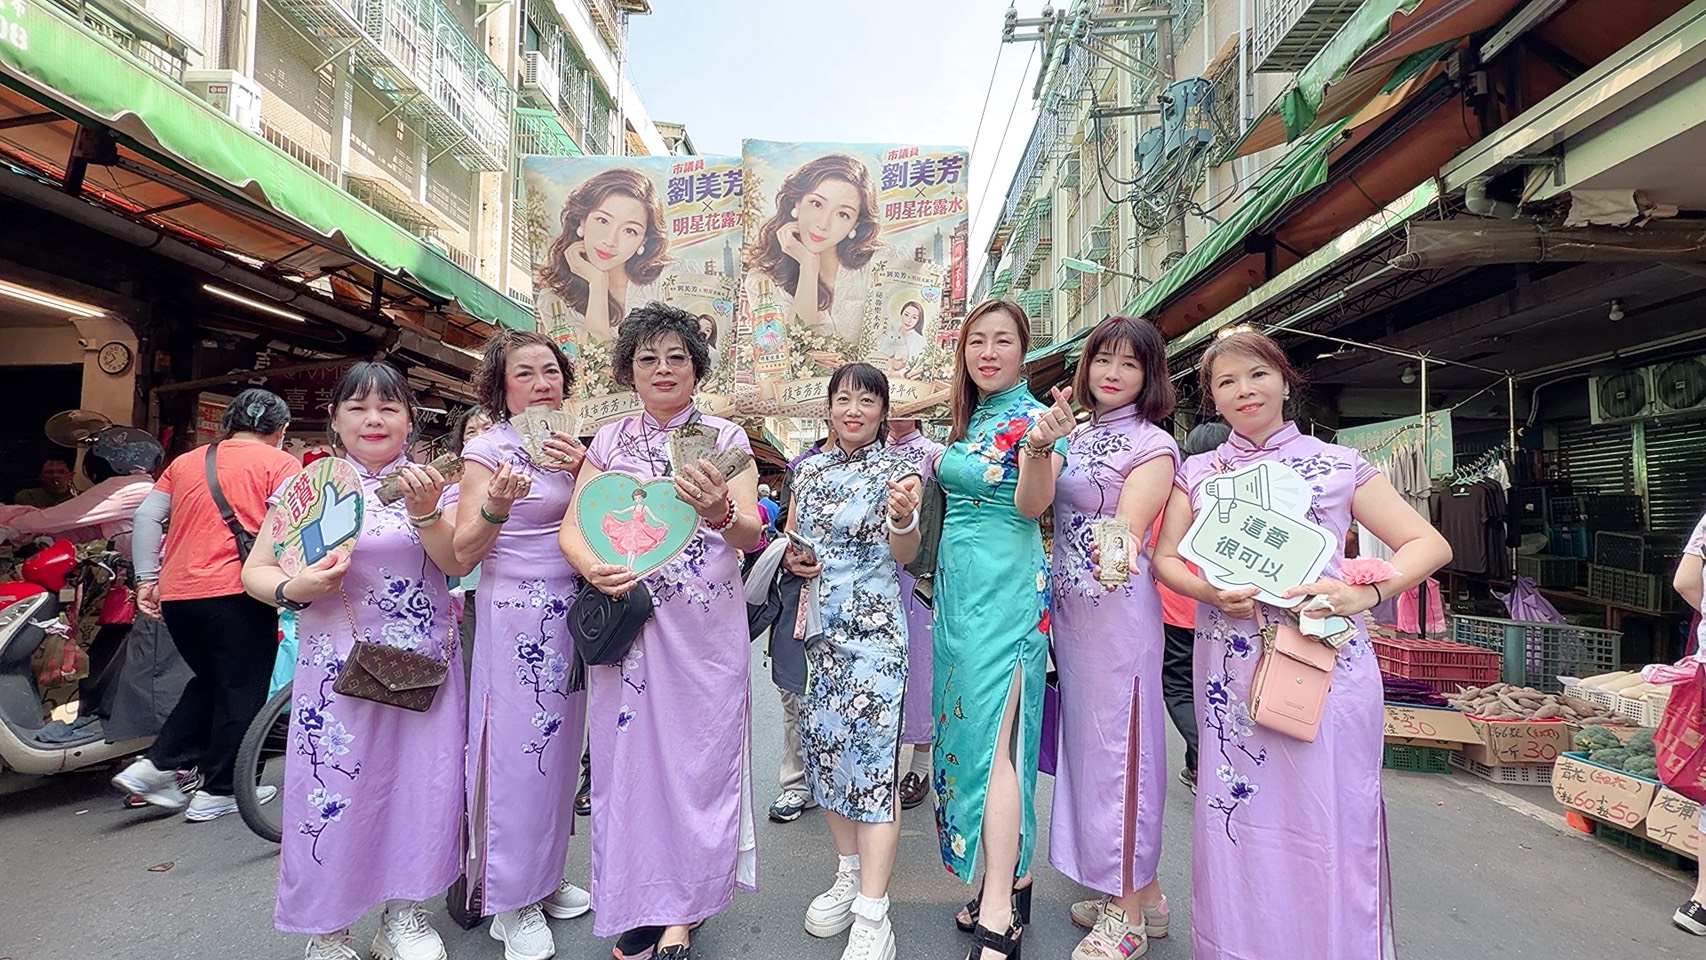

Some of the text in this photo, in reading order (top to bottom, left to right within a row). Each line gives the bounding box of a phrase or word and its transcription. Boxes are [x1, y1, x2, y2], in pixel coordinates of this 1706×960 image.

[672, 159, 705, 174] 市議員
[887, 147, 919, 161] 市議員
[667, 169, 743, 206] 劉美芳
[881, 155, 964, 191] 劉美芳
[884, 196, 964, 221] 明星花露水
[287, 472, 316, 523] 讚
[1240, 515, 1290, 550] 這香
[1214, 535, 1284, 582] 很可以
[1400, 720, 1437, 736] 30
[1501, 741, 1557, 760] 一斤 30
[1573, 791, 1596, 810] 60
[1608, 801, 1640, 824] 50
